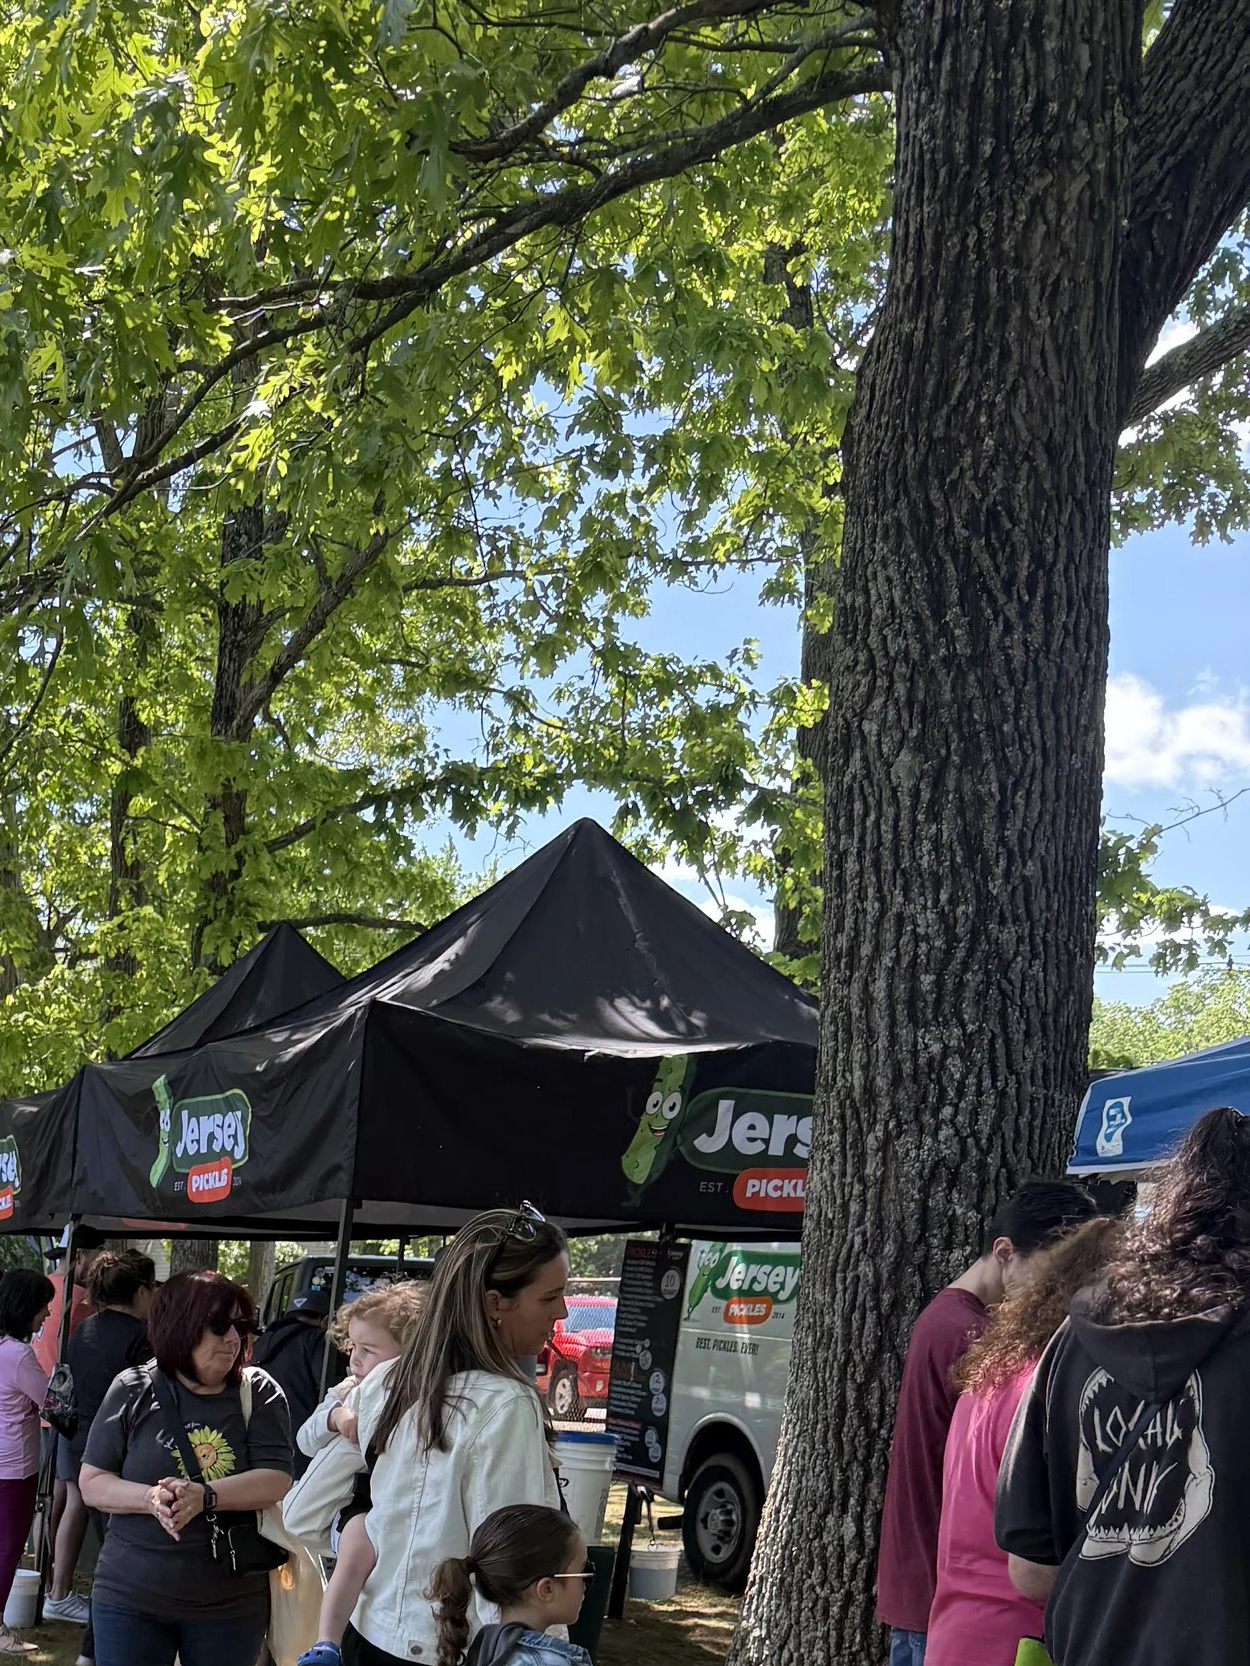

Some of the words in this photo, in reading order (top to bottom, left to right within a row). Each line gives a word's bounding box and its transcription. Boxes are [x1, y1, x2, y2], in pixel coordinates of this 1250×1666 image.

[176, 1109, 245, 1160] Jersey
[715, 1256, 800, 1301] Jersey
[728, 1303, 767, 1316] PICKLES
